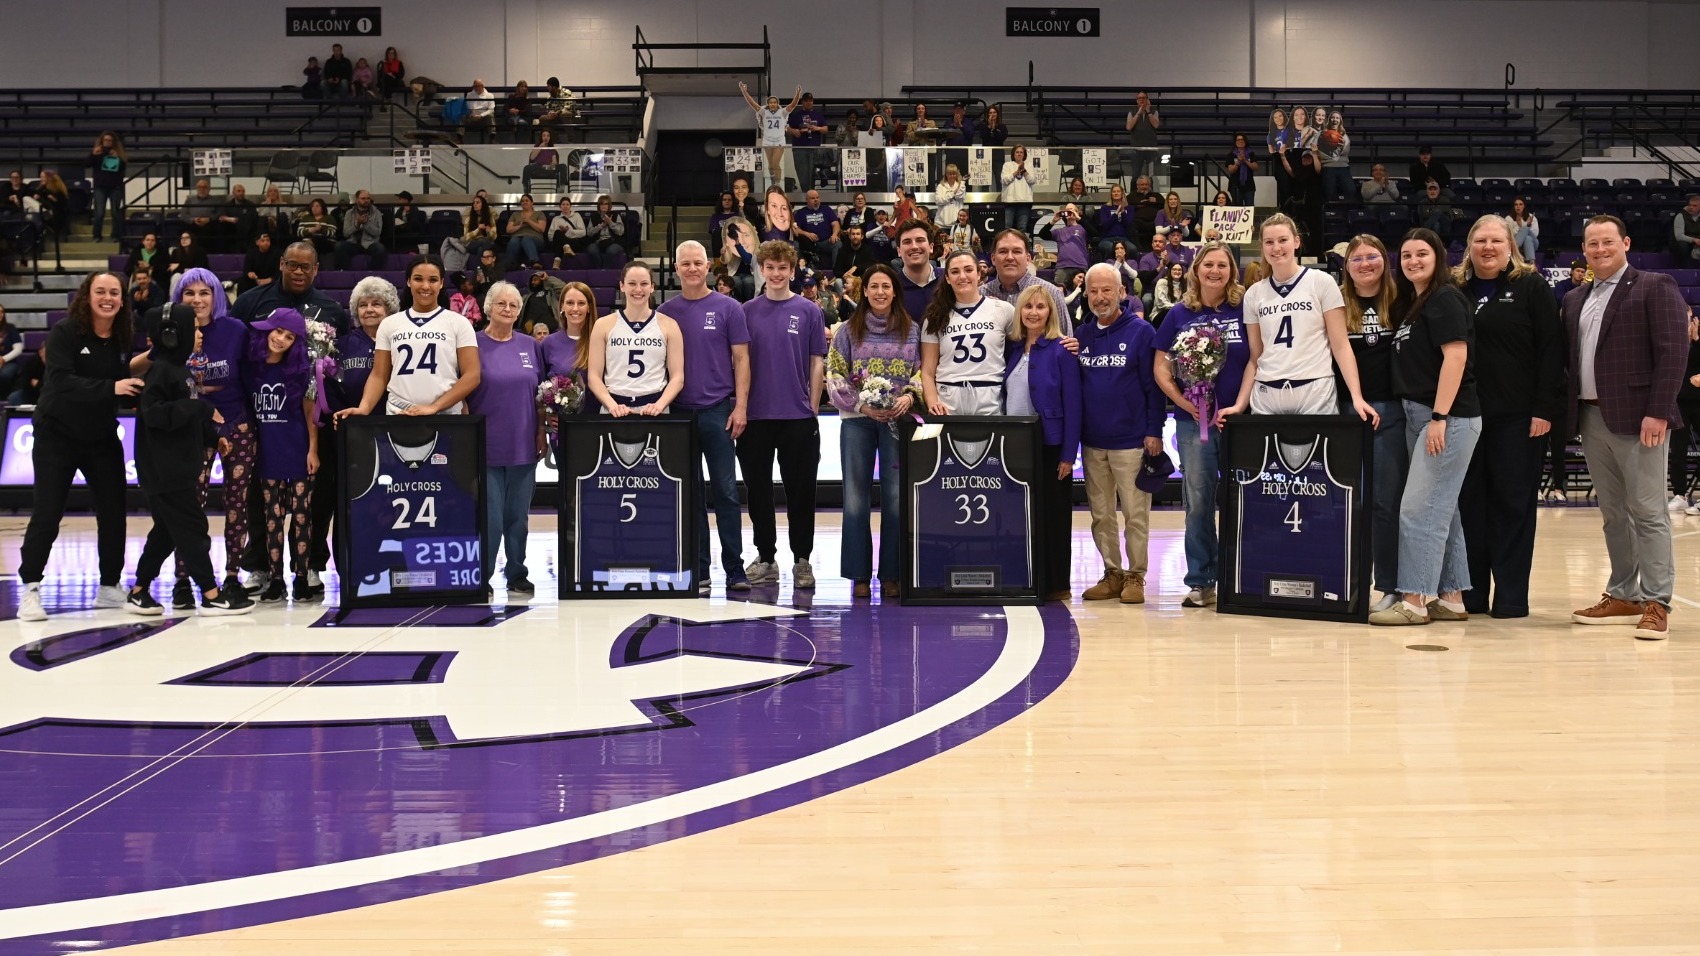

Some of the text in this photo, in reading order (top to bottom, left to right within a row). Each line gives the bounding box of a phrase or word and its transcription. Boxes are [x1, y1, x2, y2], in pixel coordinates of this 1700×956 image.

[292, 19, 351, 32] BALCONY
[1013, 20, 1070, 32] BALCONY
[767, 119, 780, 129] 24
[409, 156, 418, 167] 5
[615, 156, 629, 166] 33
[736, 155, 751, 165] 24
[843, 166, 865, 174] SENIOR
[1095, 165, 1102, 174] 5
[984, 217, 995, 232] C
[1213, 223, 1236, 231] PACK
[1258, 301, 1313, 317] HOLY CROSS
[942, 321, 994, 336] HOLY CROSS
[1273, 315, 1295, 348] 4
[392, 331, 446, 343] HOLY CROSS
[611, 337, 663, 347] HOLY CROSS
[951, 333, 987, 363] 33
[207, 360, 227, 368] SIMONE
[343, 357, 367, 370] HOLY
[397, 343, 438, 376] 24
[627, 350, 645, 378] 5
[386, 481, 442, 494] HOLY CROSS
[597, 476, 659, 489] HOLY CROSS
[941, 475, 1002, 489] HOLY CROSS
[1261, 482, 1327, 496] HOLY CROSS
[391, 496, 438, 530] 24
[620, 493, 637, 522] 5
[954, 494, 990, 524] 33
[1283, 501, 1303, 532] 4
